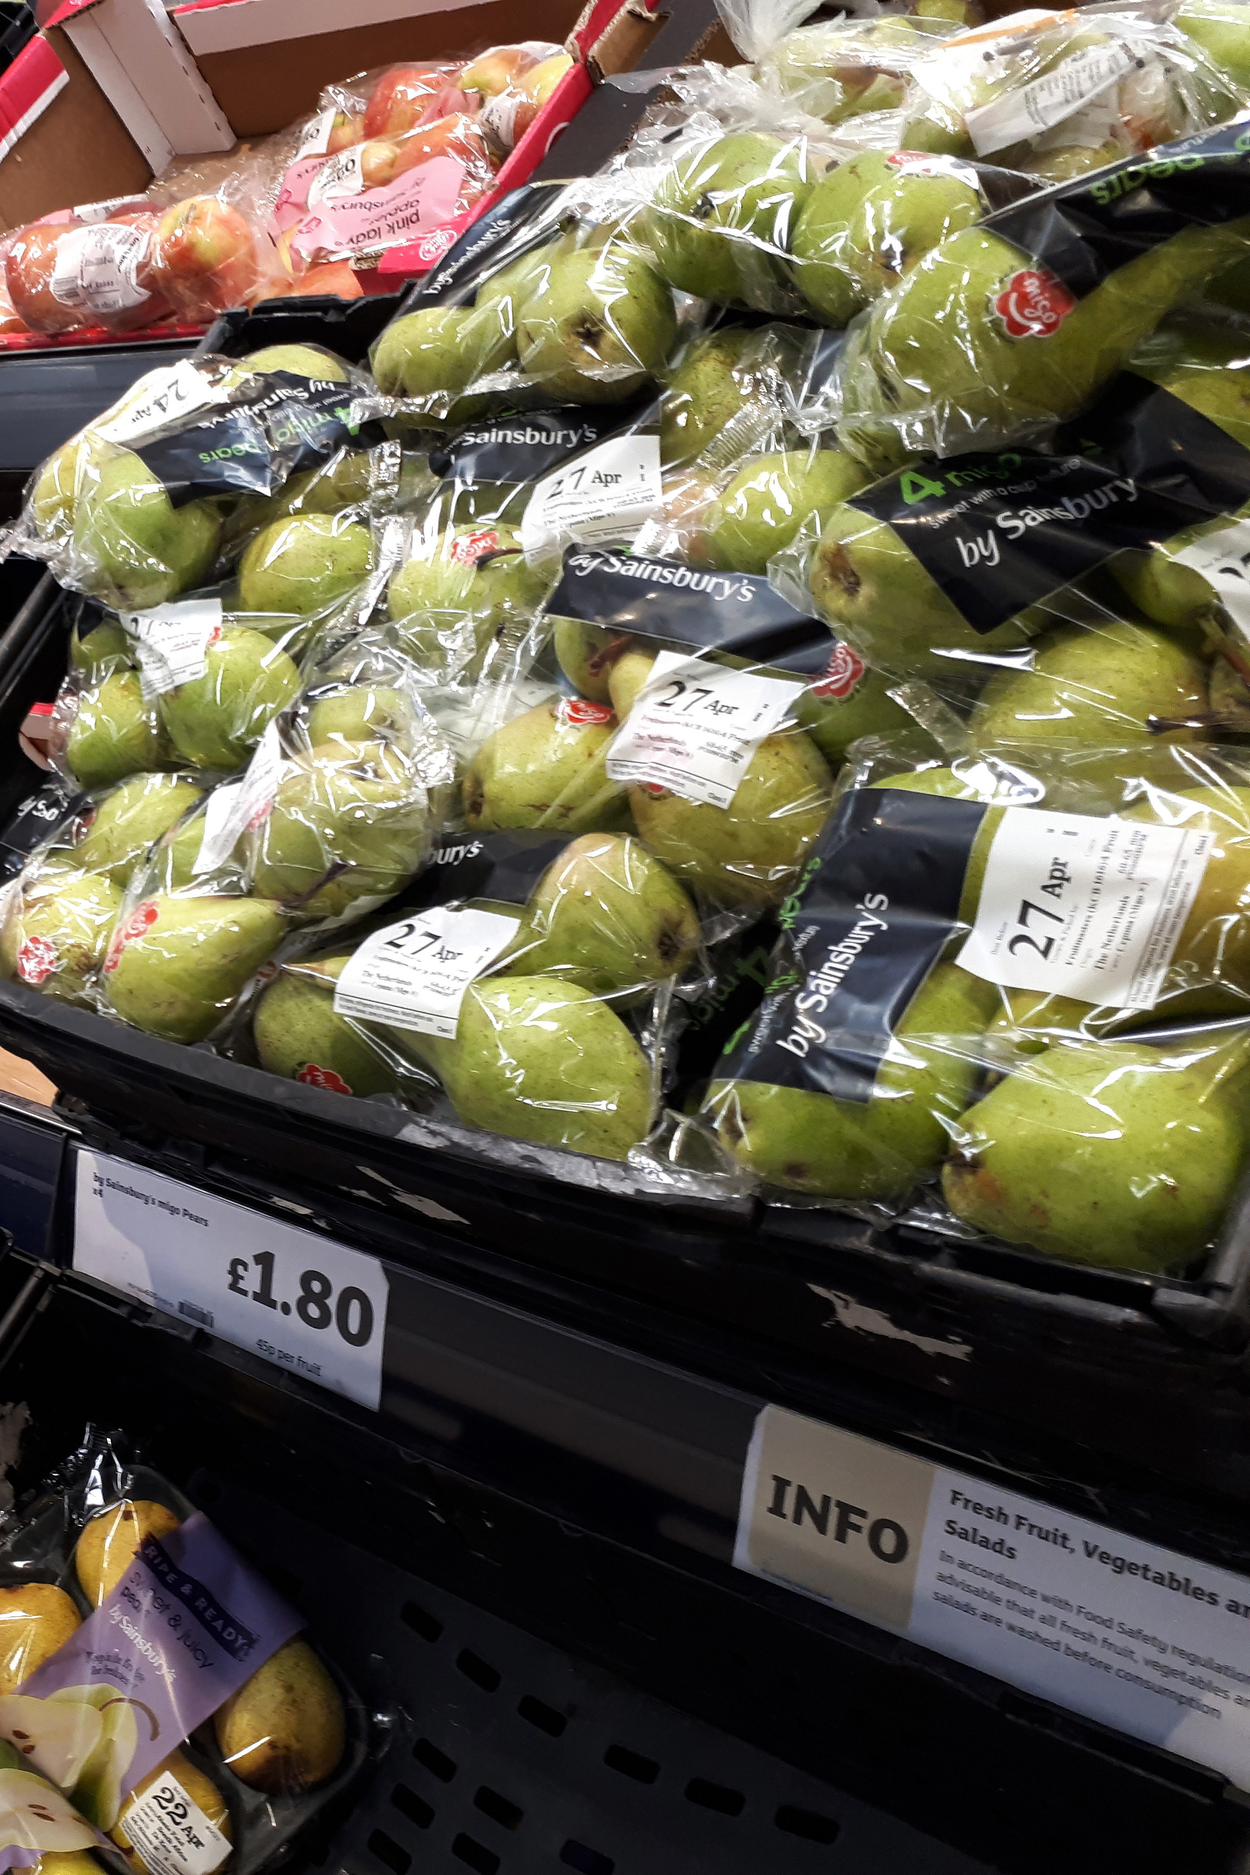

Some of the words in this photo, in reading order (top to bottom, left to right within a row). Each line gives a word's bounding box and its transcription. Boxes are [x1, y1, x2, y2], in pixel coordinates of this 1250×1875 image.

[387, 209, 420, 235] pink
[1023, 277, 1058, 324] migo
[152, 377, 190, 414] 24
[308, 378, 336, 393] by
[198, 441, 261, 464] pears
[591, 471, 623, 488] Apr
[900, 471, 947, 505] 4
[955, 529, 1000, 568] by
[602, 555, 757, 602] Sainsbury's
[654, 680, 715, 712] 27
[703, 699, 739, 716] Apr
[1008, 899, 1065, 960] 27
[1040, 857, 1072, 899] Apr
[383, 922, 442, 956] 27
[431, 945, 463, 964] Apr
[794, 893, 890, 1014] Sainsbury's
[776, 1015, 827, 1058] by
[92, 1187, 104, 1198] x4
[92, 1171, 104, 1187] by
[105, 1177, 156, 1206] Sainsbury's
[157, 1199, 181, 1216] migo
[181, 1208, 209, 1228] Pears
[226, 1251, 374, 1347] £1.80
[256, 1338, 276, 1356] 45p
[277, 1348, 295, 1364] per
[297, 1355, 323, 1377] fruit
[766, 1474, 910, 1564] INFO
[944, 1519, 1016, 1560] Salads
[950, 1489, 1010, 1526] Fresh
[1013, 1514, 1076, 1554] Fruit,
[1082, 1539, 1220, 1606] Vegetables
[144, 1544, 179, 1585] RIPE
[179, 1583, 193, 1597] &
[194, 1596, 249, 1650] READY
[938, 1550, 955, 1566] In
[956, 1557, 1038, 1600] accordance
[1039, 1590, 1073, 1614] with
[1075, 1604, 1115, 1630] Food
[1116, 1621, 1169, 1655] Safety
[108, 1604, 123, 1625] by
[118, 1614, 178, 1684] Sainsbury's
[167, 1613, 182, 1632] &
[177, 1629, 216, 1670] juicy
[932, 1589, 978, 1618] salads
[980, 1610, 1004, 1627] are
[1006, 1621, 1061, 1653] washed
[1063, 1642, 1112, 1674] before
[1115, 1667, 1222, 1720] consumption
[936, 1571, 1002, 1606] advisable
[1005, 1598, 1035, 1620] that
[1037, 1612, 1057, 1629] all
[1059, 1618, 1098, 1646] fresh
[1101, 1635, 1139, 1664] fruit,
[1143, 1656, 1230, 1700] vegetables
[151, 1786, 188, 1826] 22
[180, 1825, 206, 1851] Apr
